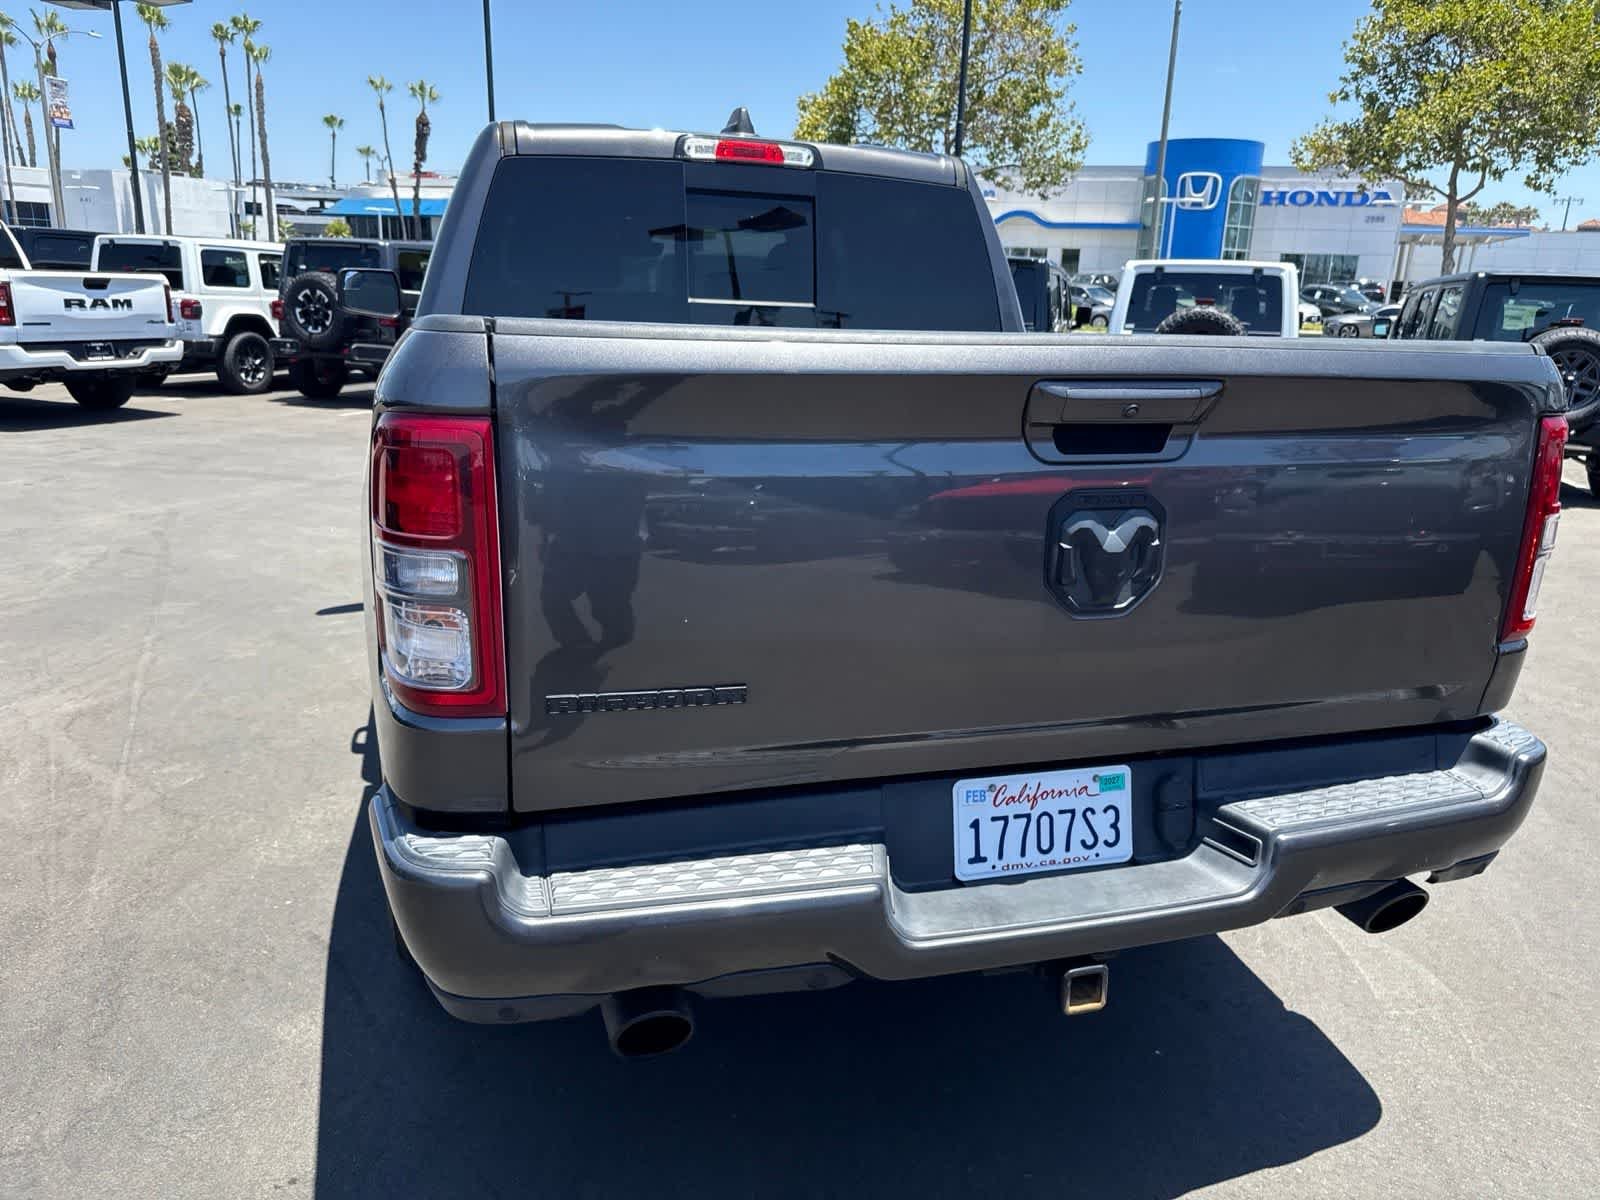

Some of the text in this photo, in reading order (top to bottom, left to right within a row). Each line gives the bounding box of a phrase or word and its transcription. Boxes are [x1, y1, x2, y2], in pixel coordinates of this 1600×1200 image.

[1260, 190, 1397, 208] HONDA
[63, 298, 134, 310] RAM
[1103, 775, 1120, 785] 2027
[965, 789, 987, 804] FEB
[992, 779, 1100, 811] California
[967, 804, 1121, 865] 17707S3
